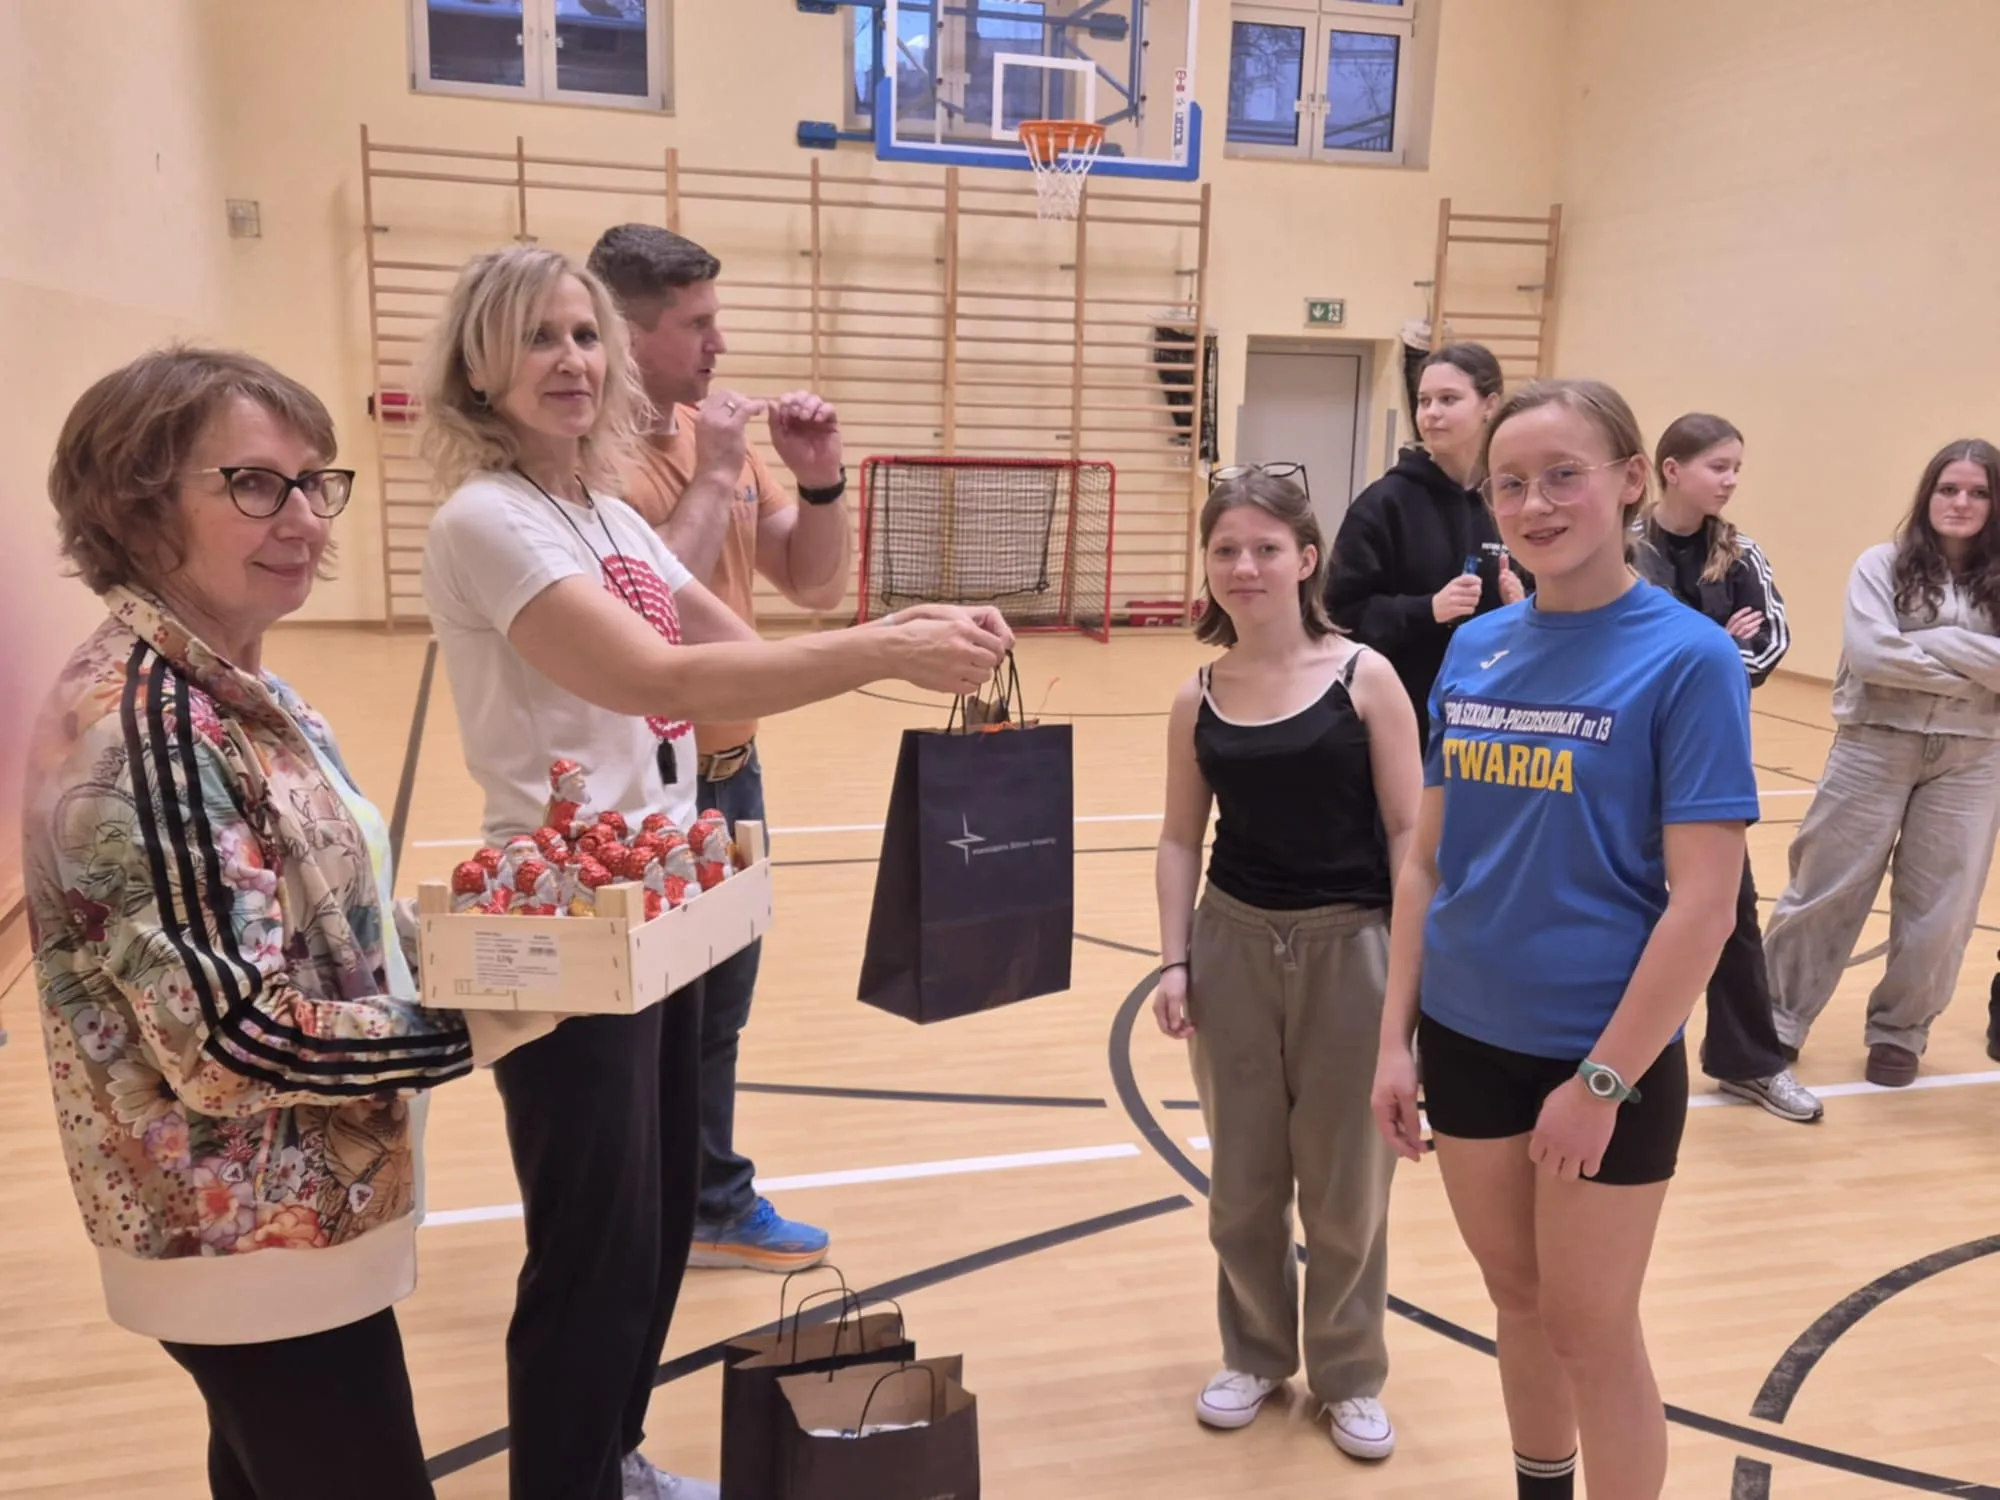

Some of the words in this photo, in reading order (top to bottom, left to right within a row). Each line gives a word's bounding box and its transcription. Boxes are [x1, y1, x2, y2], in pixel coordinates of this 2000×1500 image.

[1581, 719, 1597, 738] nr
[1596, 716, 1613, 741] 13
[1443, 739, 1574, 793] TWARDA
